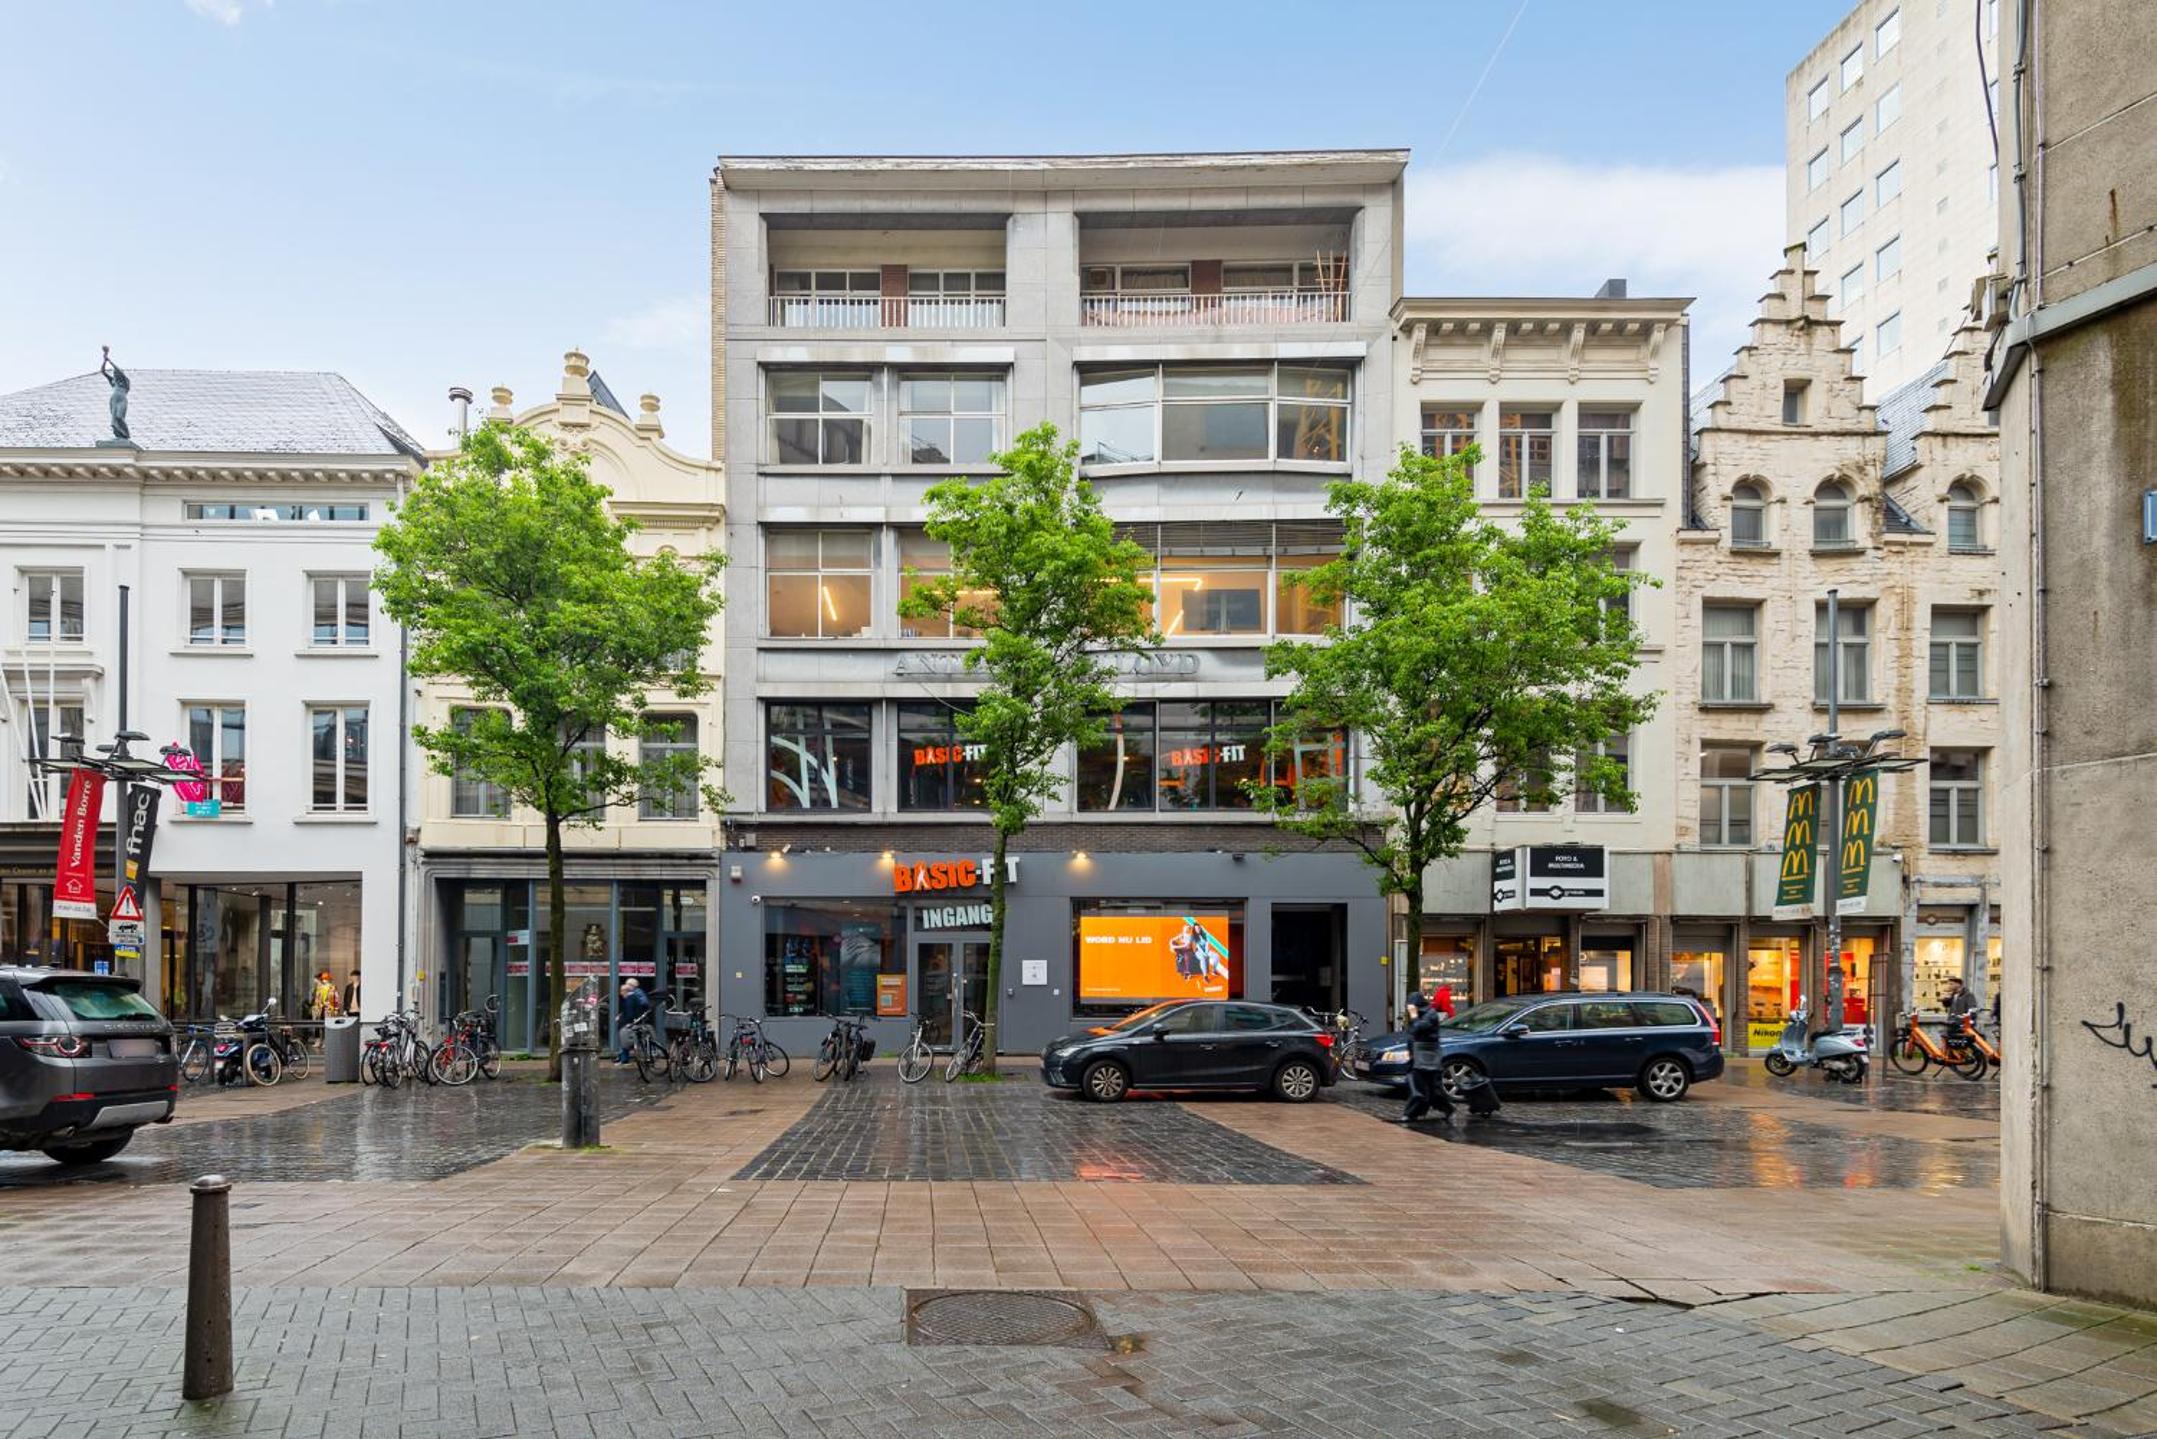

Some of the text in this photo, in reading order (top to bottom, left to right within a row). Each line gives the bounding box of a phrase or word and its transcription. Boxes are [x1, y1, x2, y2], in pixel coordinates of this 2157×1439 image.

[70, 780, 92, 867] Vanden Borre
[126, 793, 150, 855] fnac
[894, 856, 1020, 893] BASIC-FT
[922, 903, 993, 929] INGANG
[1753, 1028, 1783, 1037] Nikon
